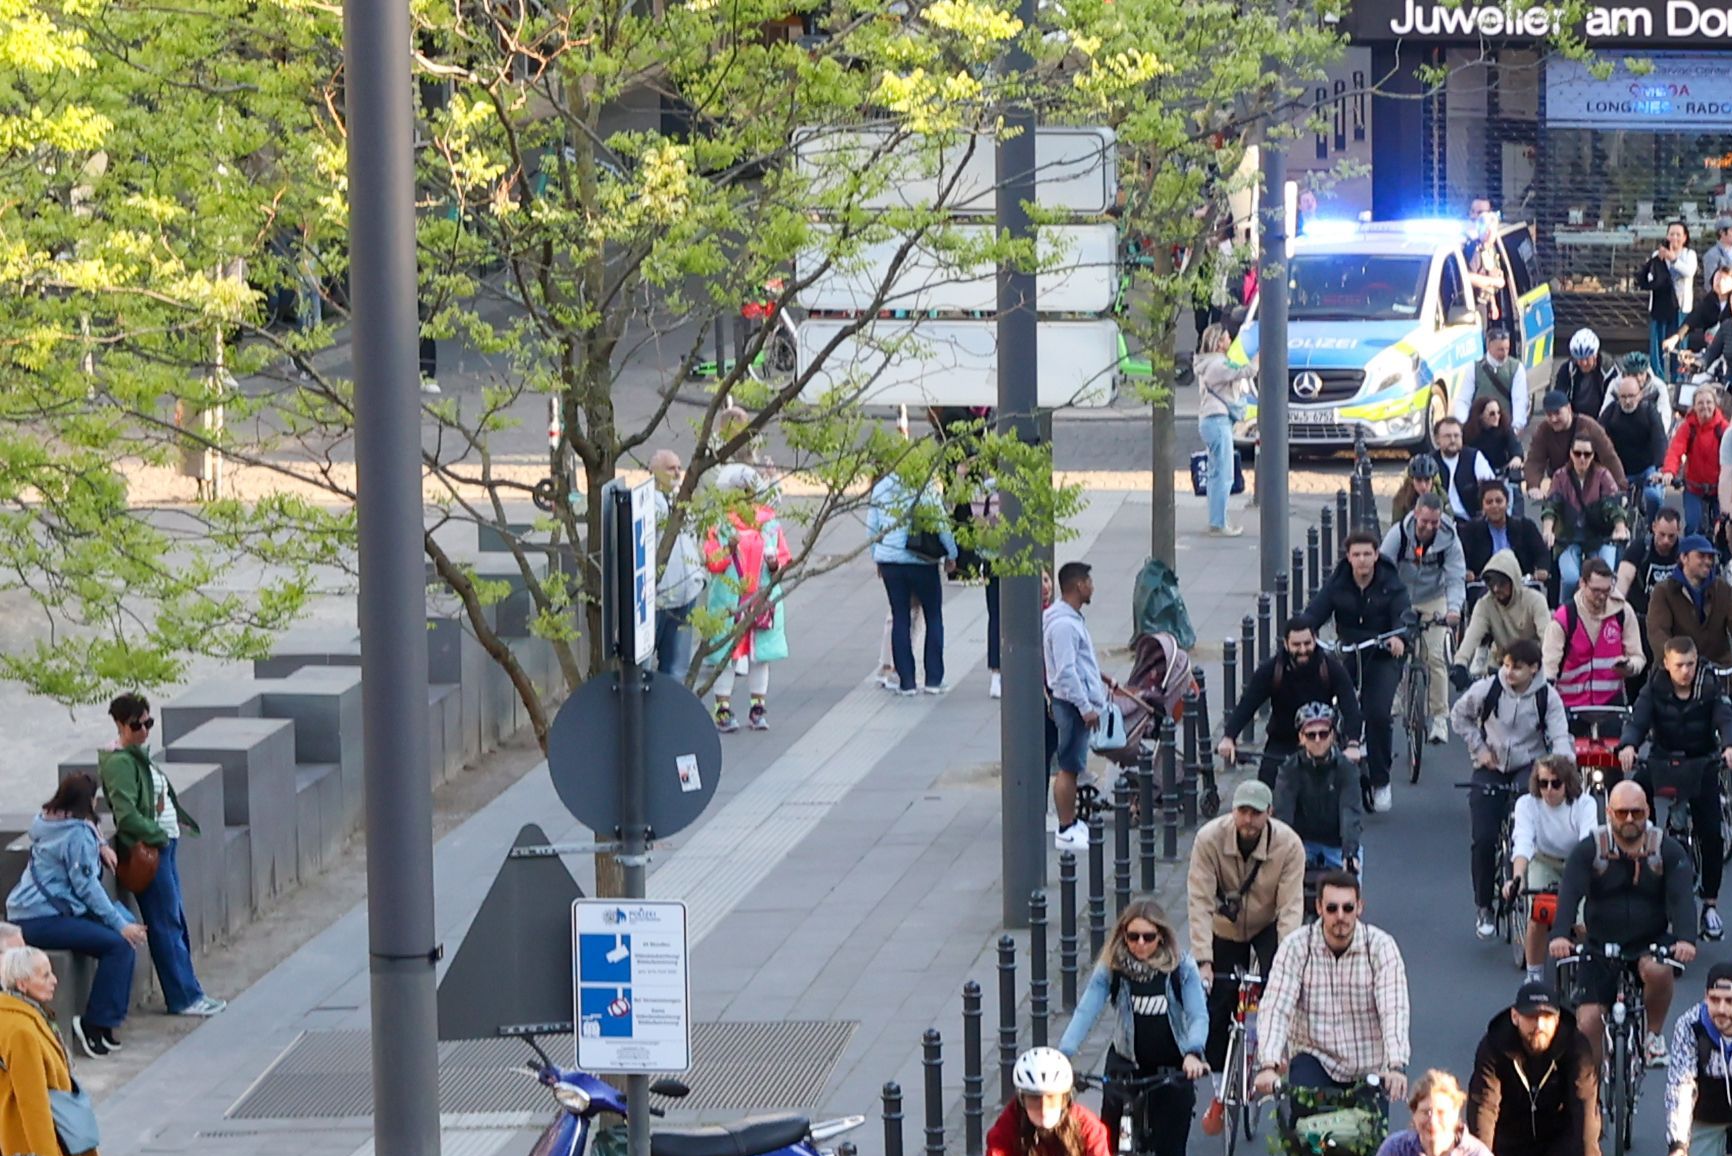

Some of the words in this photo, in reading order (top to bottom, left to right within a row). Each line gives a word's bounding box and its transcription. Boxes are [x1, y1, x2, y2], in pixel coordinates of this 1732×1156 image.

[1586, 6, 1652, 36] am
[1685, 102, 1732, 114] RADO
[1288, 337, 1359, 349] OLIZEI
